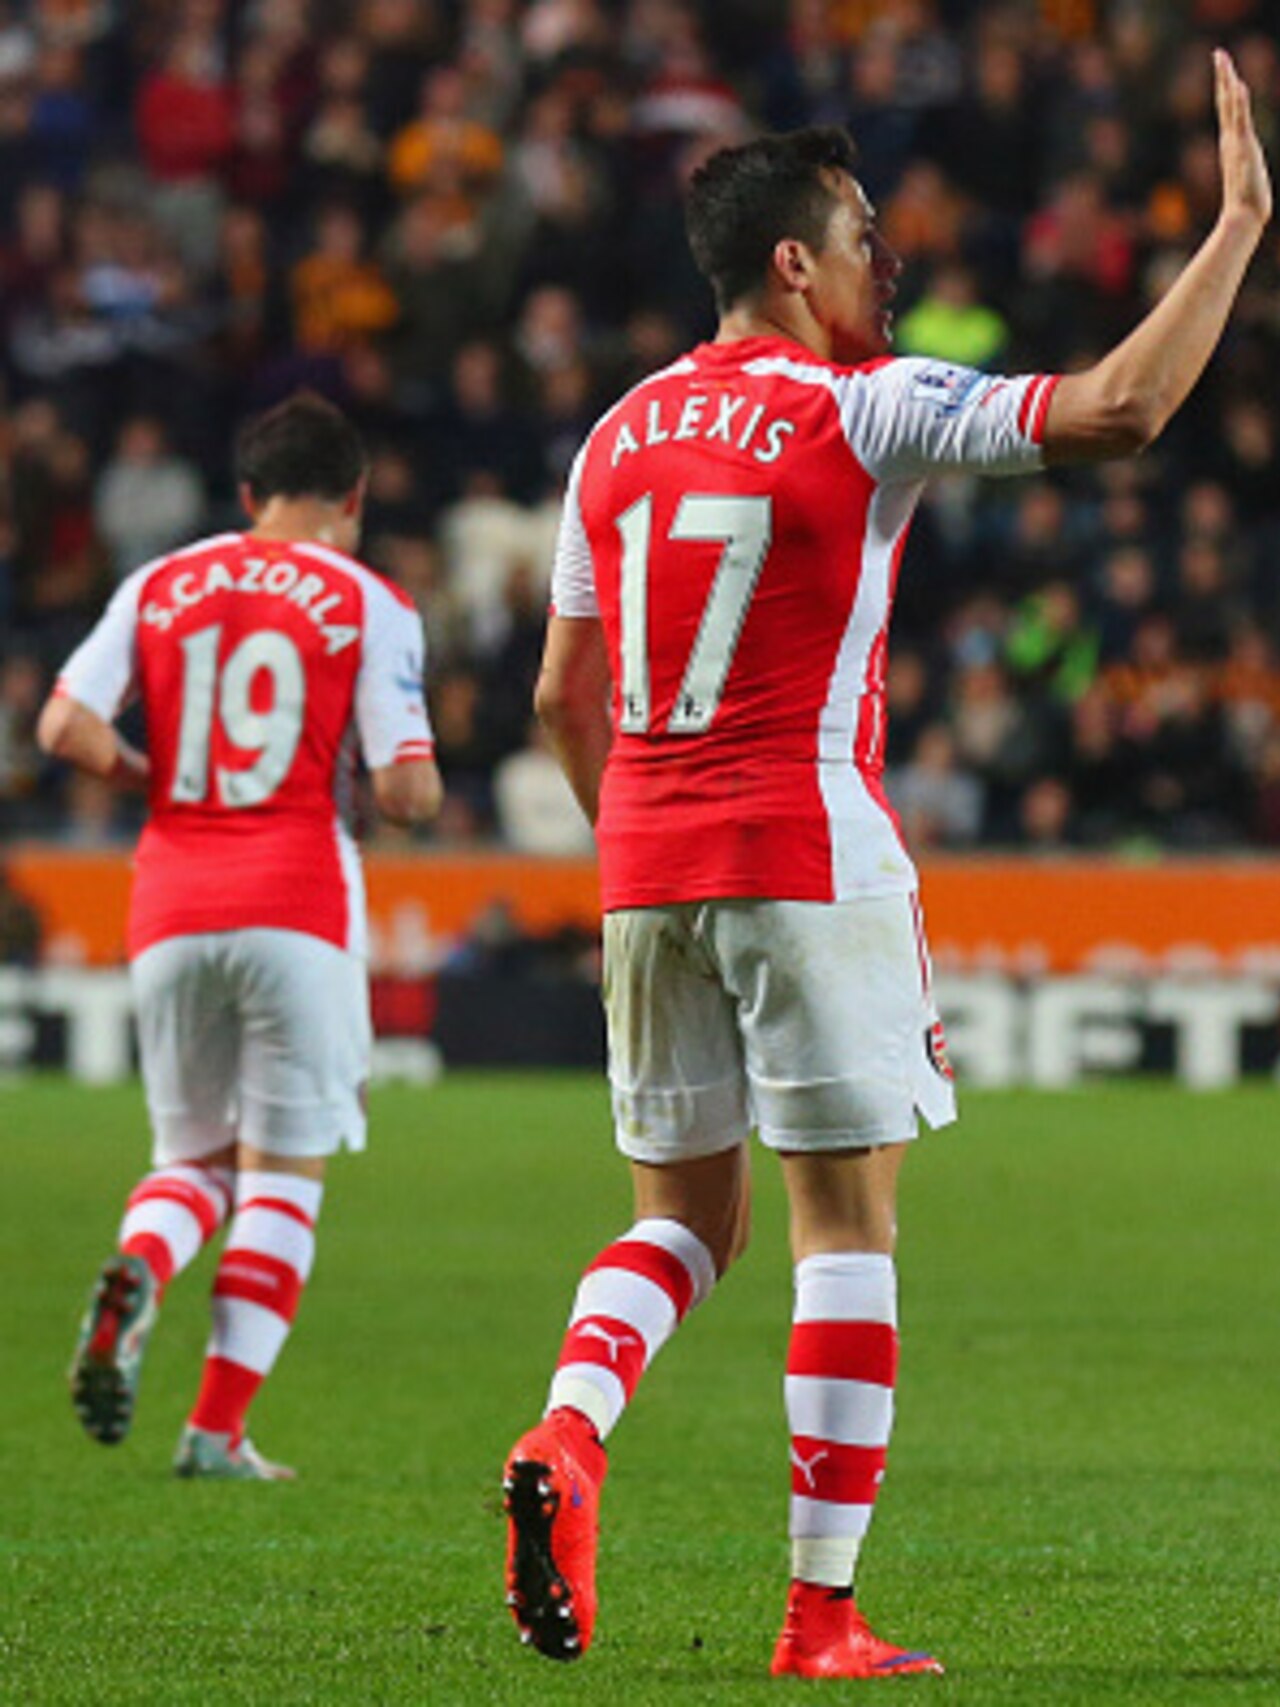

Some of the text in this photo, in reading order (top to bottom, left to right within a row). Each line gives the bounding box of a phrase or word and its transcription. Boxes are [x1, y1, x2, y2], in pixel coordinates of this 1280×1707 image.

[611, 394, 795, 463] ALEXIS
[141, 558, 360, 656] S.CAZORLA
[614, 491, 772, 734] 17
[170, 622, 306, 809] 19
